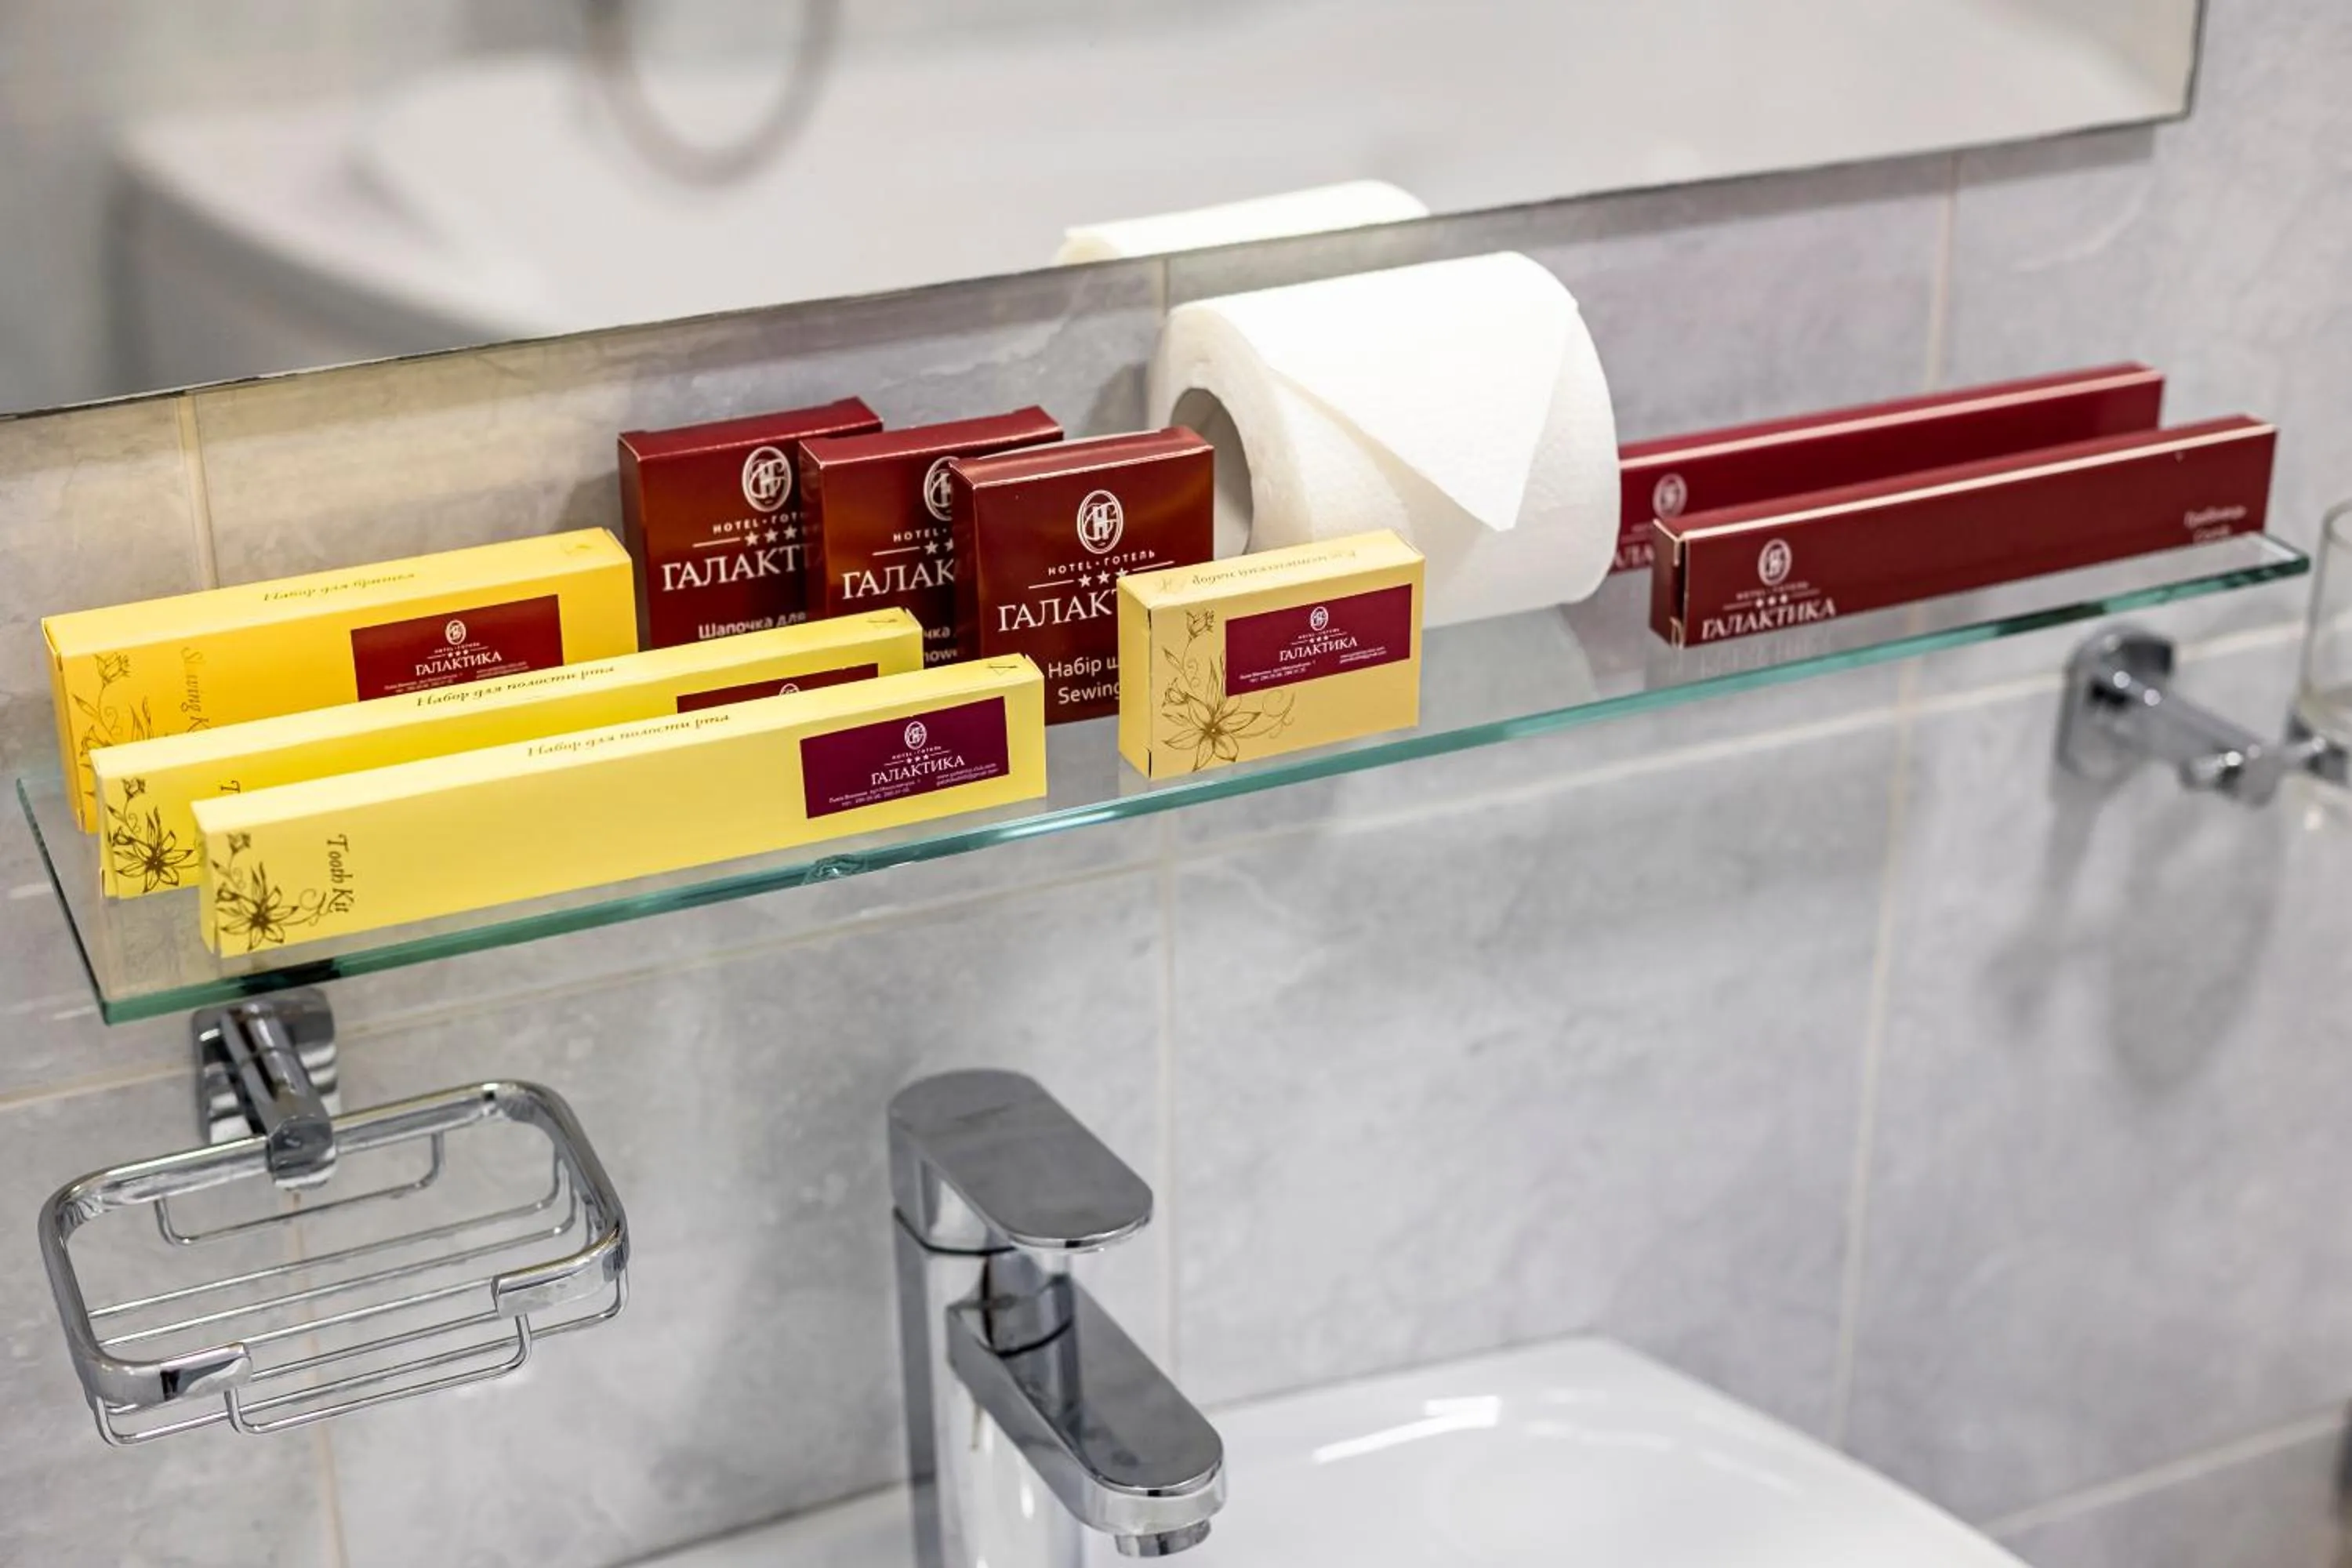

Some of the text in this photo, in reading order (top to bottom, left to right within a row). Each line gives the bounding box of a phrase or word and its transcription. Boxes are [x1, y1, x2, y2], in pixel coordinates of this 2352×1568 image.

[712, 512, 798, 535] HOTEL ГОТ
[893, 528, 938, 543] HOTEL
[661, 545, 800, 592] ГАЛАКТ
[1047, 549, 1156, 576] HOTEL ГОТЕЛЬ
[841, 558, 954, 600] ГАЛАК
[997, 588, 1118, 632] ГАЛАК
[1701, 597, 1837, 641] ГАЛАКТИКА
[698, 615, 774, 640] Шапочка
[1279, 636, 1358, 662] ГАЛАКТИКА
[415, 650, 503, 677] ГАЛАКТИКА
[1047, 656, 1102, 679] Набір
[417, 691, 470, 707] Набор
[870, 755, 965, 785] ГАЛАКТИКА
[326, 833, 355, 914] Tooth Kit
